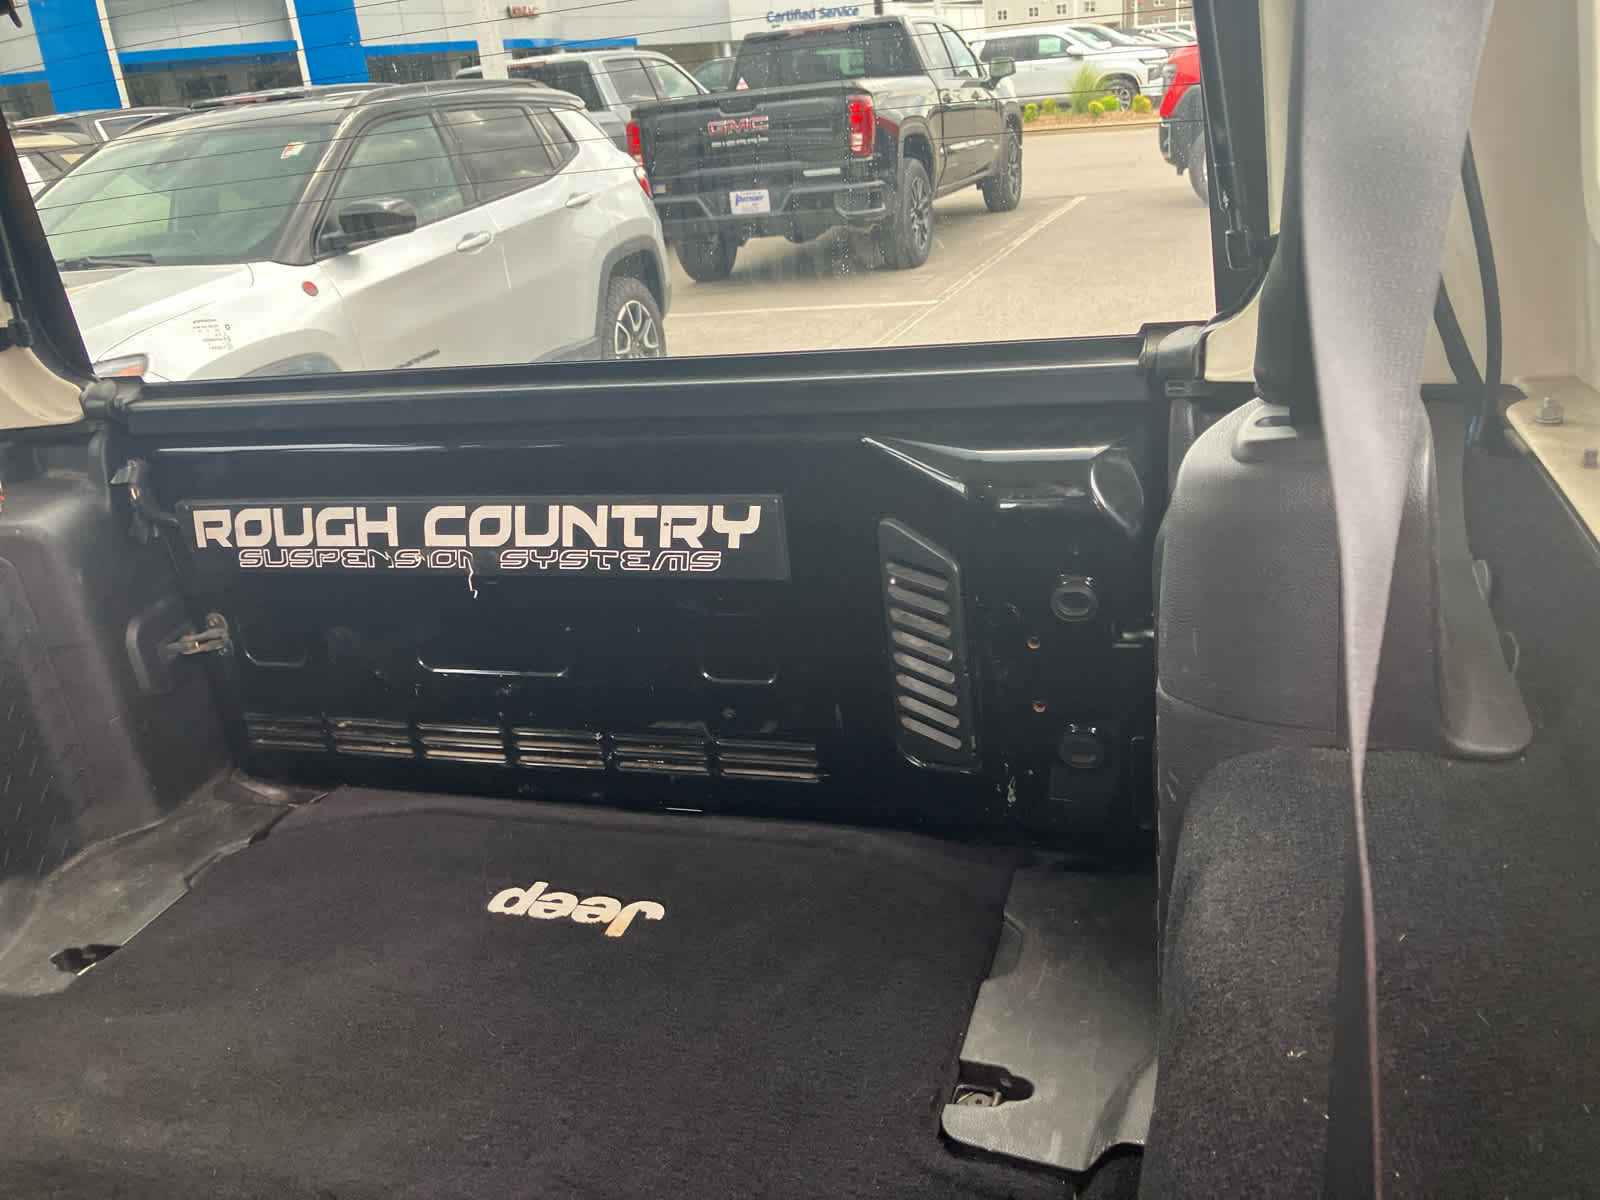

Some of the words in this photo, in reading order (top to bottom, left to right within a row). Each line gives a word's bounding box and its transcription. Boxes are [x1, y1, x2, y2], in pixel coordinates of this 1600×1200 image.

[767, 8, 816, 23] Certified
[819, 7, 860, 19] Service
[707, 115, 769, 135] GMC
[193, 506, 399, 548] ROUGH
[424, 504, 761, 549] COUNTRY
[500, 549, 722, 571] SYSTEMS
[487, 881, 665, 937] Jeep
